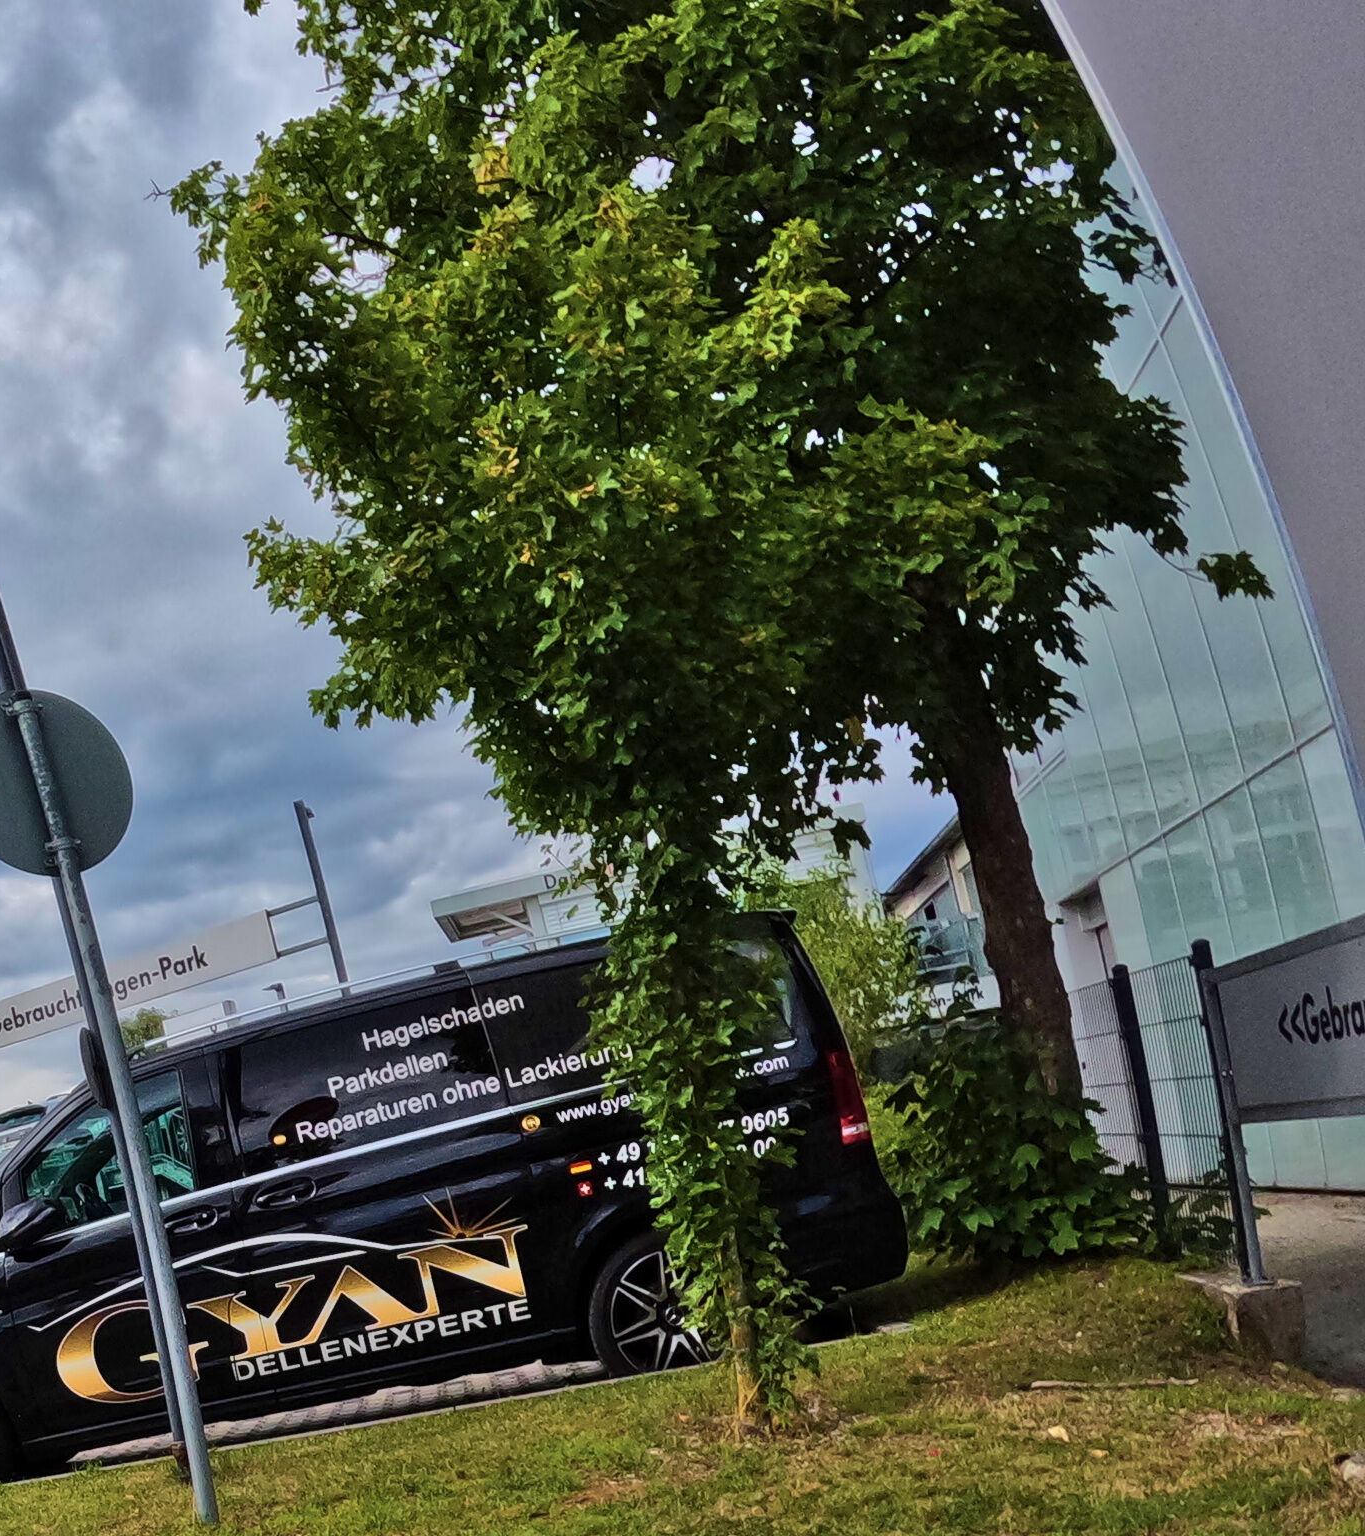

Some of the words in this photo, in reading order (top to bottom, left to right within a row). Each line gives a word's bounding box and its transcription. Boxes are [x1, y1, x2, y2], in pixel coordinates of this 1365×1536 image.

[361, 994, 525, 1051] Hagelschaden
[327, 1051, 449, 1098] Parkdellen
[295, 1091, 438, 1144] Reparaturen
[442, 1076, 501, 1105] ohne
[616, 1142, 641, 1164] 49
[622, 1166, 645, 1189] 41
[56, 1224, 529, 1403] GYAN
[232, 1299, 532, 1382] DELLENEXPERTE
